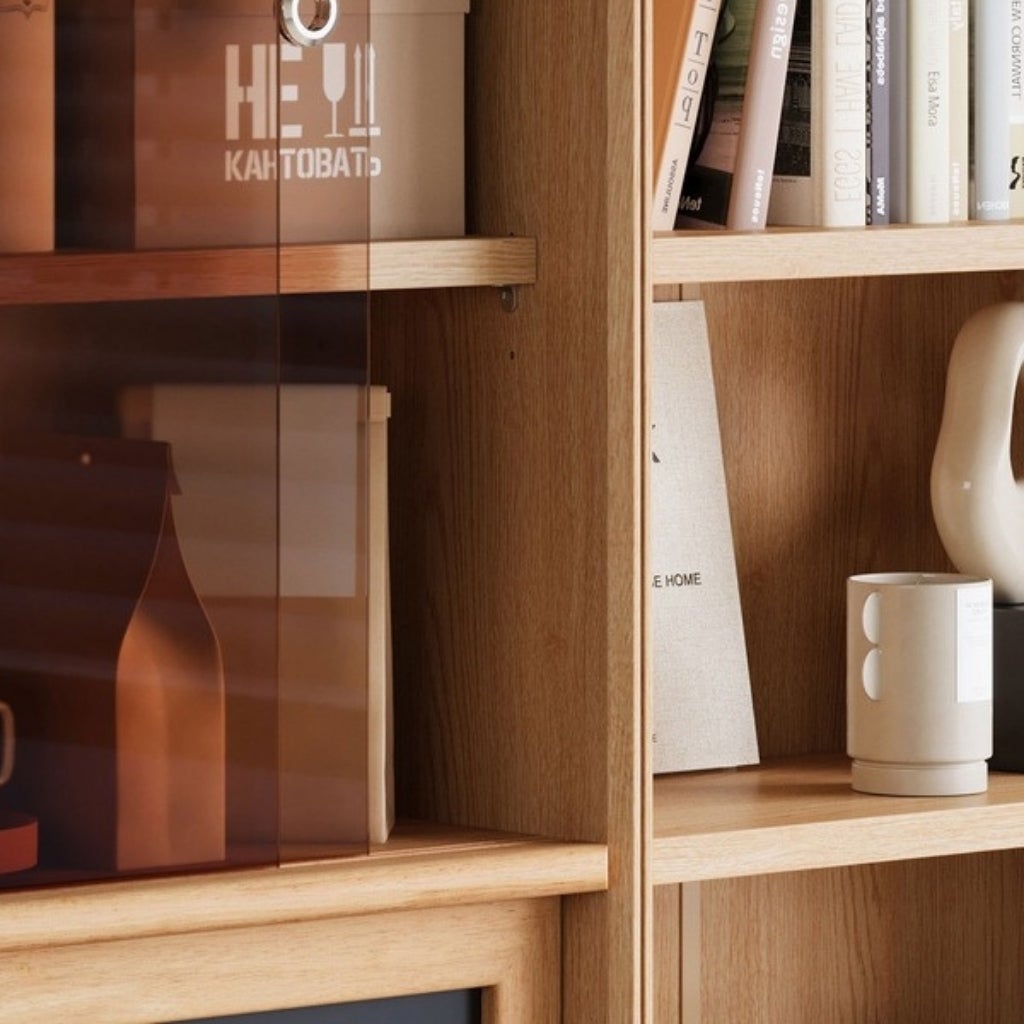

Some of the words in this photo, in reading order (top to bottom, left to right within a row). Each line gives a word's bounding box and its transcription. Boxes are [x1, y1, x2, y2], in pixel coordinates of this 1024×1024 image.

[225, 44, 303, 140] НЕ
[926, 95, 941, 127] Mora
[225, 147, 381, 181] КАНТОВАТЬ
[666, 573, 702, 587] HOME
